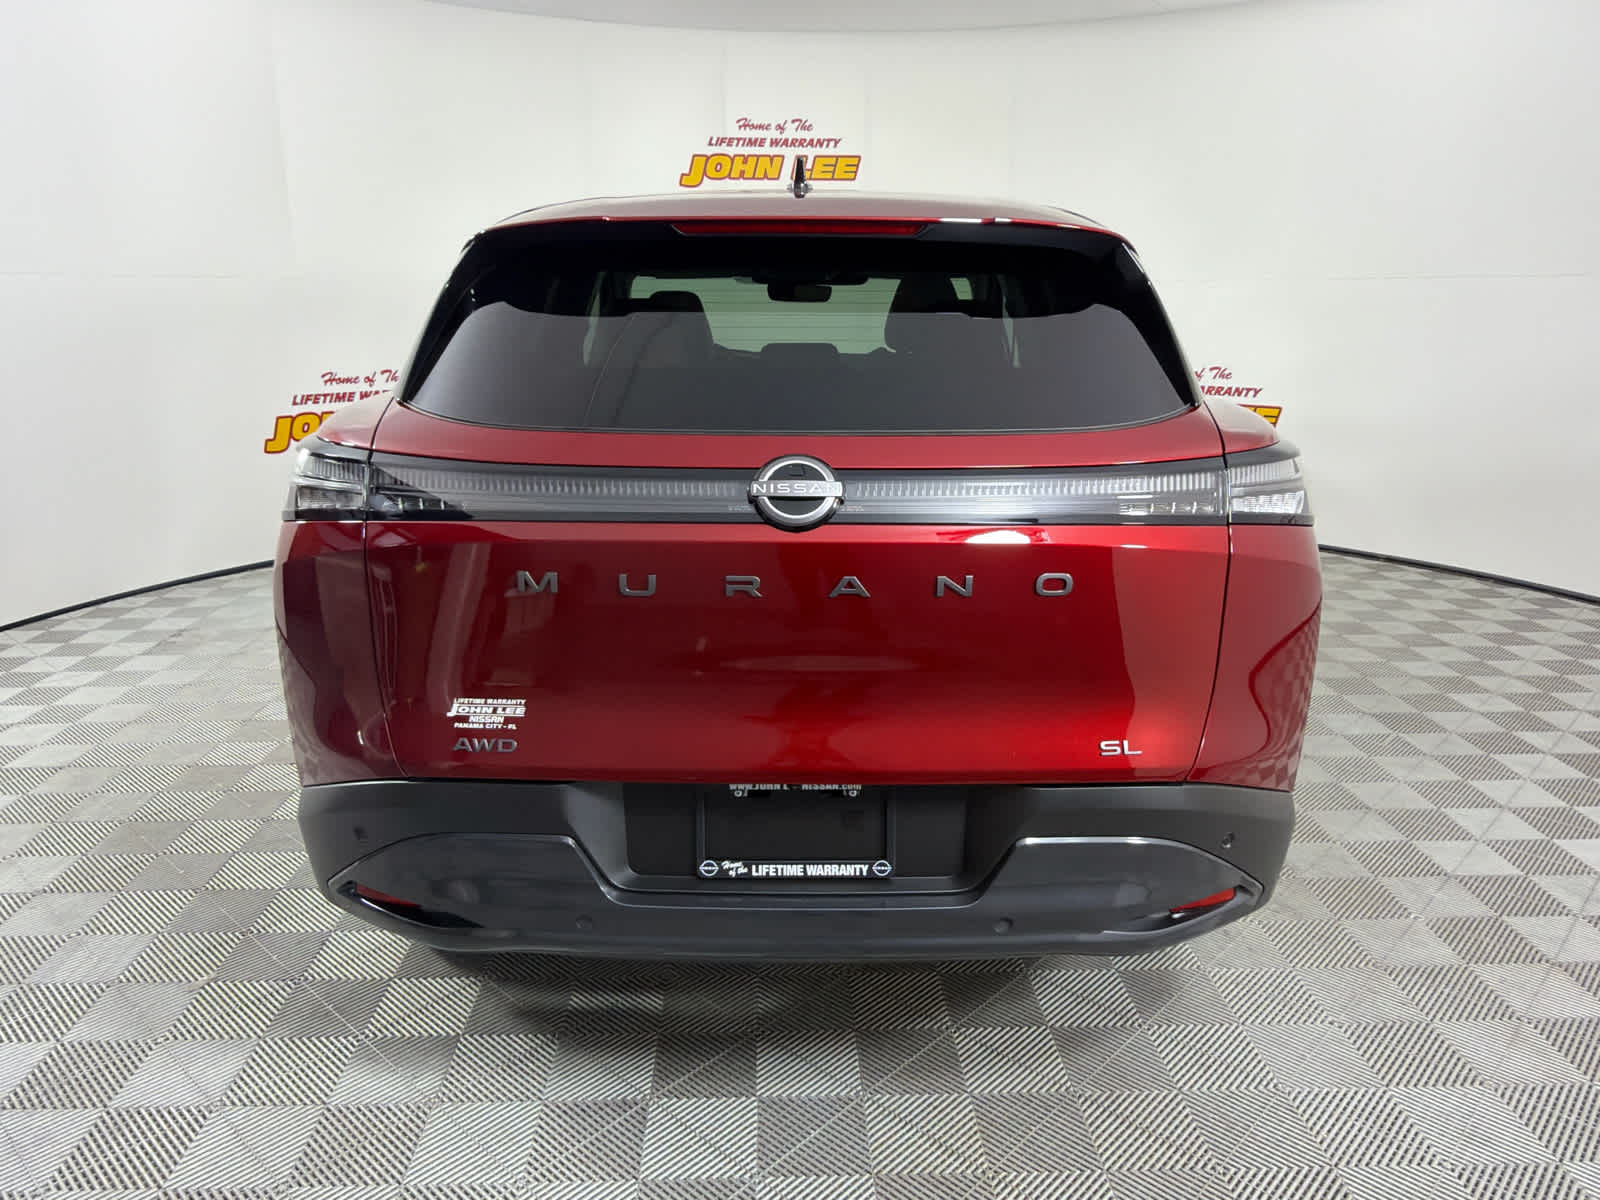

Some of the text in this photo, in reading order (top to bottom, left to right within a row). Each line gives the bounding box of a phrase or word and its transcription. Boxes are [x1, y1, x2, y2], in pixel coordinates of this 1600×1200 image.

[736, 117, 814, 134] Home of The
[707, 136, 842, 149] LIFETIME WARRANTY
[679, 153, 784, 188] JOHN
[321, 369, 399, 387] Home of Th
[1209, 366, 1232, 380] The
[291, 391, 356, 406] LIFETIME
[264, 411, 335, 454] JO
[752, 483, 841, 494] NISSAN
[516, 570, 1074, 598] MURANO
[454, 697, 485, 705] LIFETIME
[446, 703, 527, 717] JOHN LEE
[468, 715, 504, 723] NISSAN
[452, 737, 518, 752] AWD
[1099, 739, 1143, 756] SL
[721, 860, 743, 870] Home
[728, 867, 737, 877] of
[752, 864, 804, 876] LIFETIME
[806, 864, 869, 876] WARRANTY
